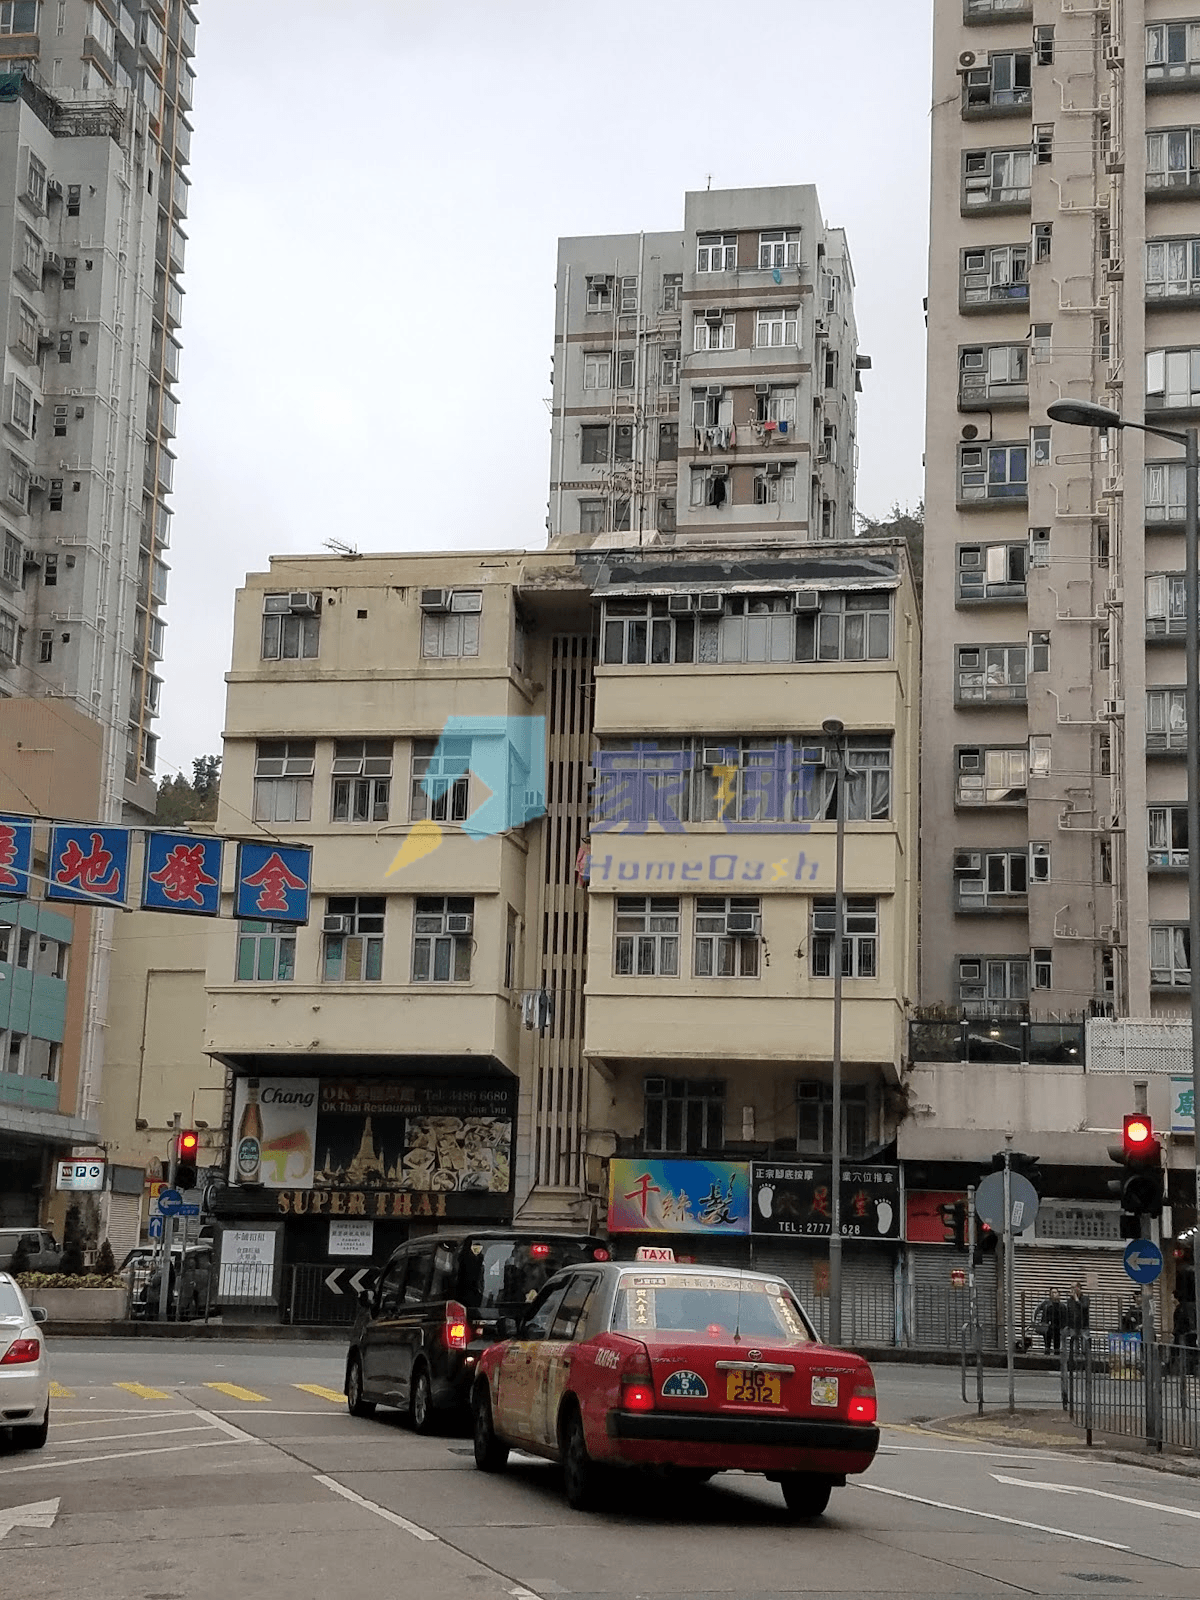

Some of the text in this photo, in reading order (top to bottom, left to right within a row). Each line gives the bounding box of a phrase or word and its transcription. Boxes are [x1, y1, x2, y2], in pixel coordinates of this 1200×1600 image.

[260, 1087, 315, 1107] Chang
[321, 1102, 422, 1113] OK Thai Restaurant
[277, 1191, 447, 1216] SUPER THAI
[806, 1222, 831, 1235] 2777
[840, 1224, 861, 1235] 628
[642, 1248, 672, 1261] TAXI
[675, 1372, 698, 1381] TAXI
[742, 1372, 766, 1387] HG
[681, 1378, 690, 1389] 5
[670, 1388, 700, 1396] SEATS
[733, 1385, 774, 1403] 2312
